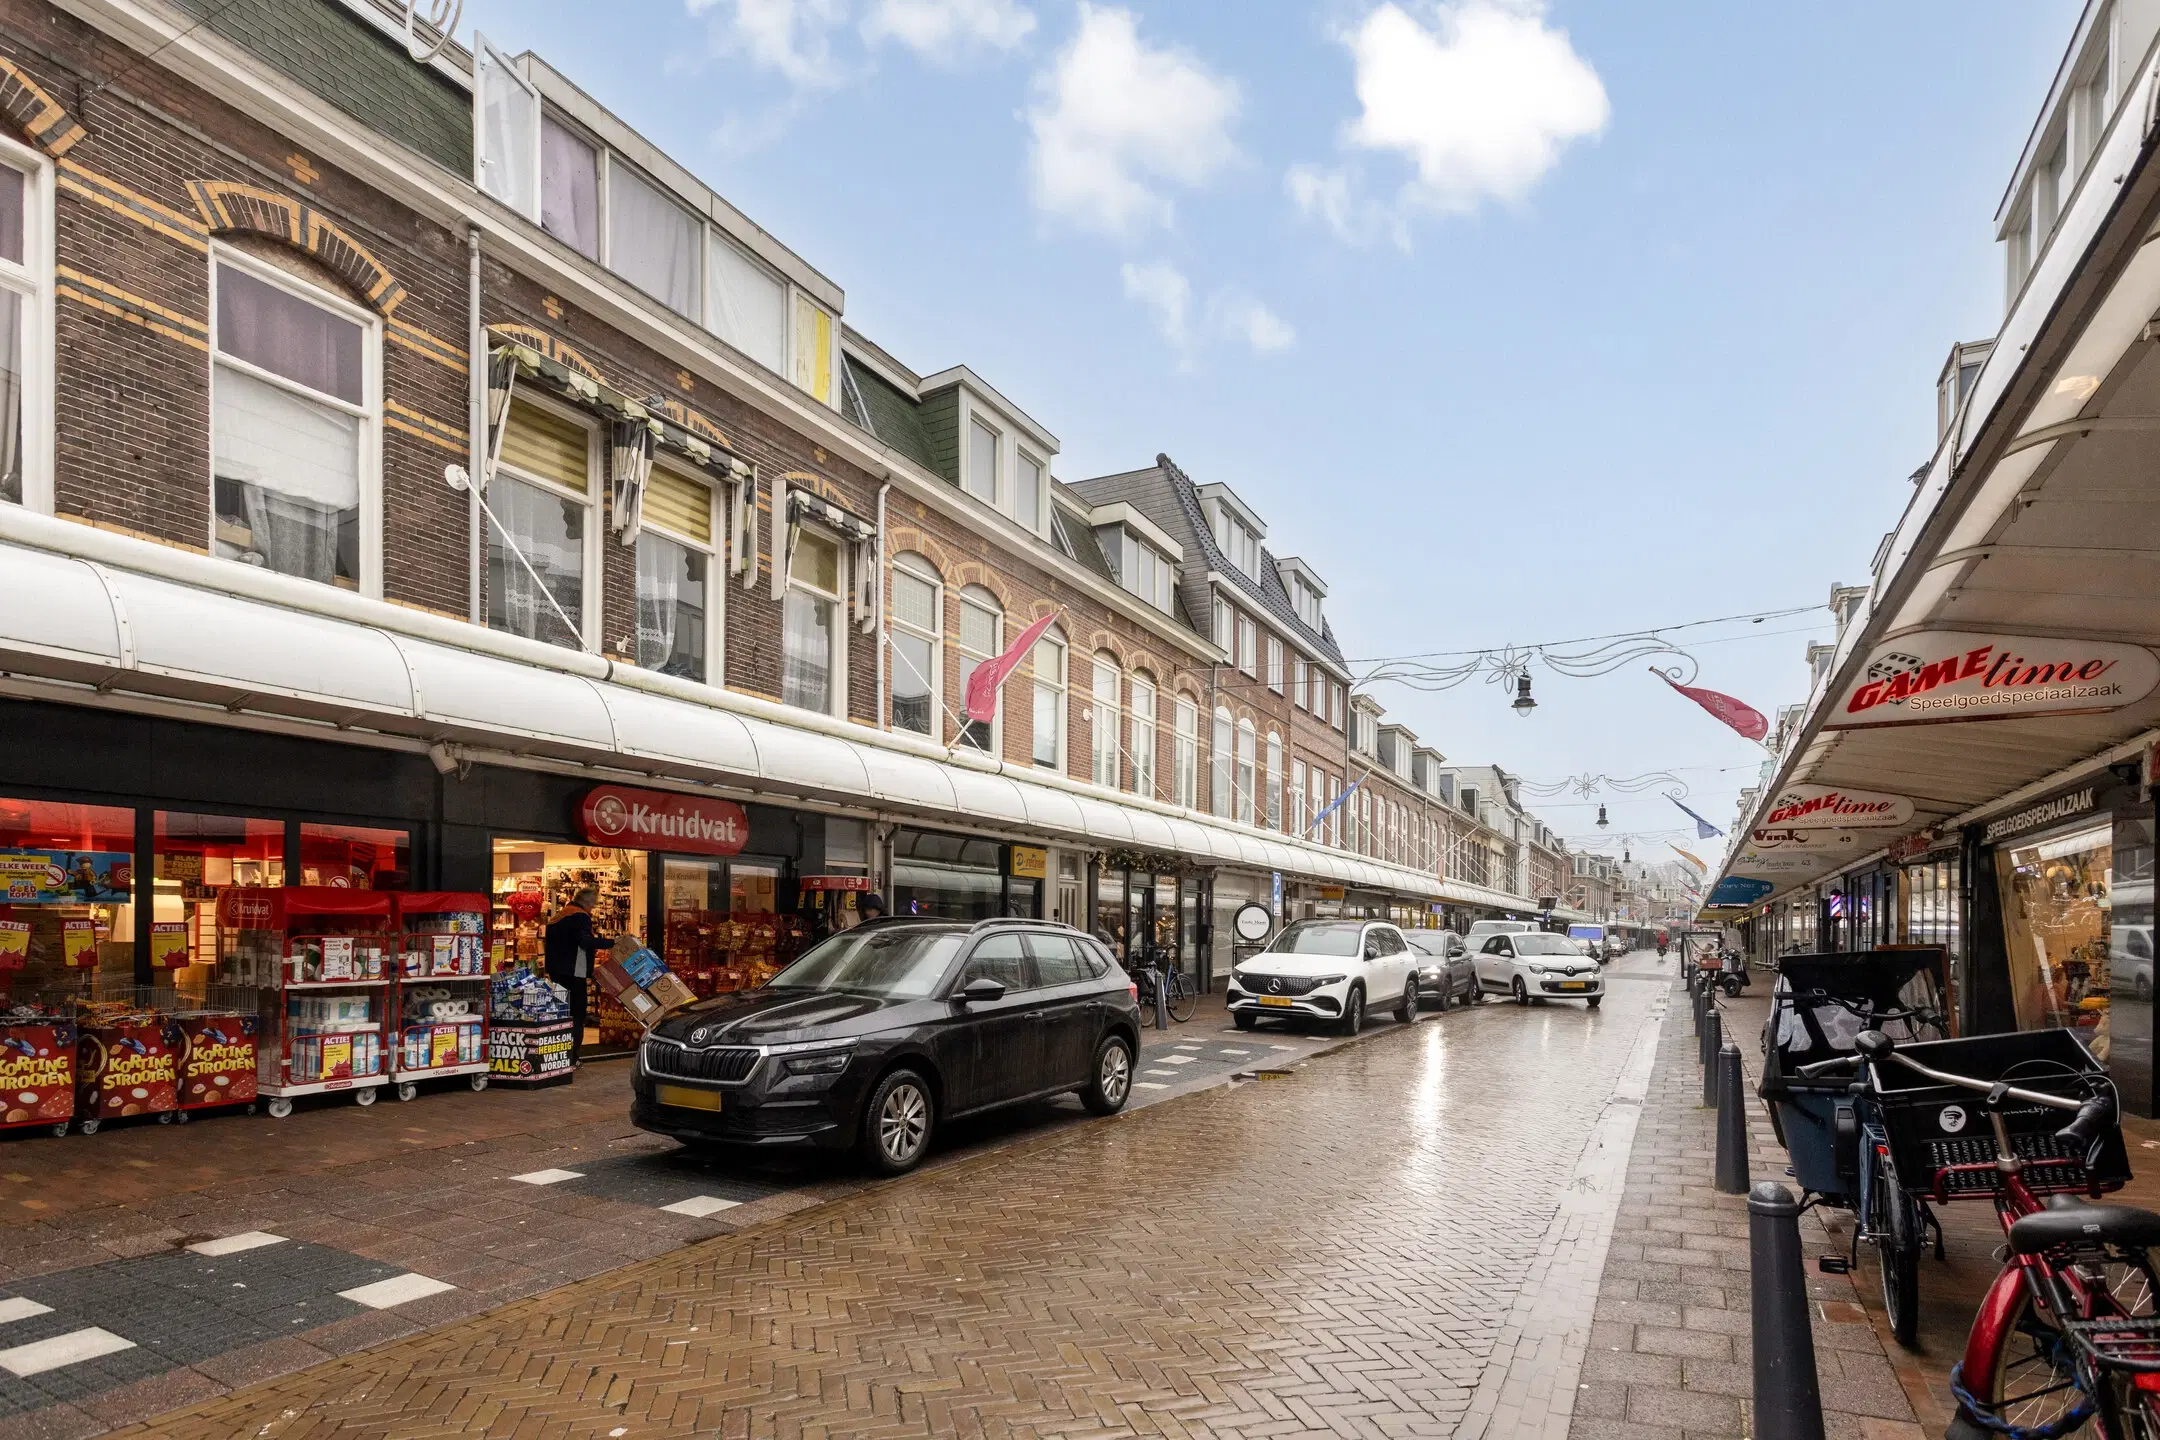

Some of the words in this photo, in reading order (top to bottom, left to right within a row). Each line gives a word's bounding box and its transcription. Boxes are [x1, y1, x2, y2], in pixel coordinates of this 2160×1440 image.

[1909, 682, 2122, 711] Speelgoedspeciaalzaak
[1798, 813, 1898, 825] Speelgoedspeciaalzaak
[1986, 787, 2094, 840] SPEELGOEDSPECIAALZAAK
[631, 803, 737, 843] Kruidvat
[1752, 829, 1808, 843] Vink
[0, 862, 20, 870] ELKE
[22, 863, 47, 871] WEEK
[239, 903, 270, 916] Kruidvat
[0, 920, 29, 931] CTIE!
[64, 921, 92, 930] ACTIE!
[153, 924, 184, 932] ACTIE!
[434, 1025, 457, 1035] ACTIE!
[323, 1035, 350, 1045] ACTIE!
[490, 1031, 526, 1047] LACK
[193, 1043, 253, 1064] KORTING
[489, 1045, 528, 1060] RIDAY
[538, 1042, 573, 1055] HEBBERIG
[109, 1054, 173, 1073] KORTING
[543, 1053, 559, 1062] VAN
[559, 1051, 568, 1059] TE
[0, 1056, 68, 1076] KORTING
[187, 1057, 256, 1077] STROOIEN
[489, 1059, 520, 1073] EALS
[540, 1059, 570, 1072] WORDEN
[0, 1071, 73, 1090] TROOIEN
[103, 1068, 176, 1090] STROOIEN
[2002, 1105, 2054, 1116] annetje
